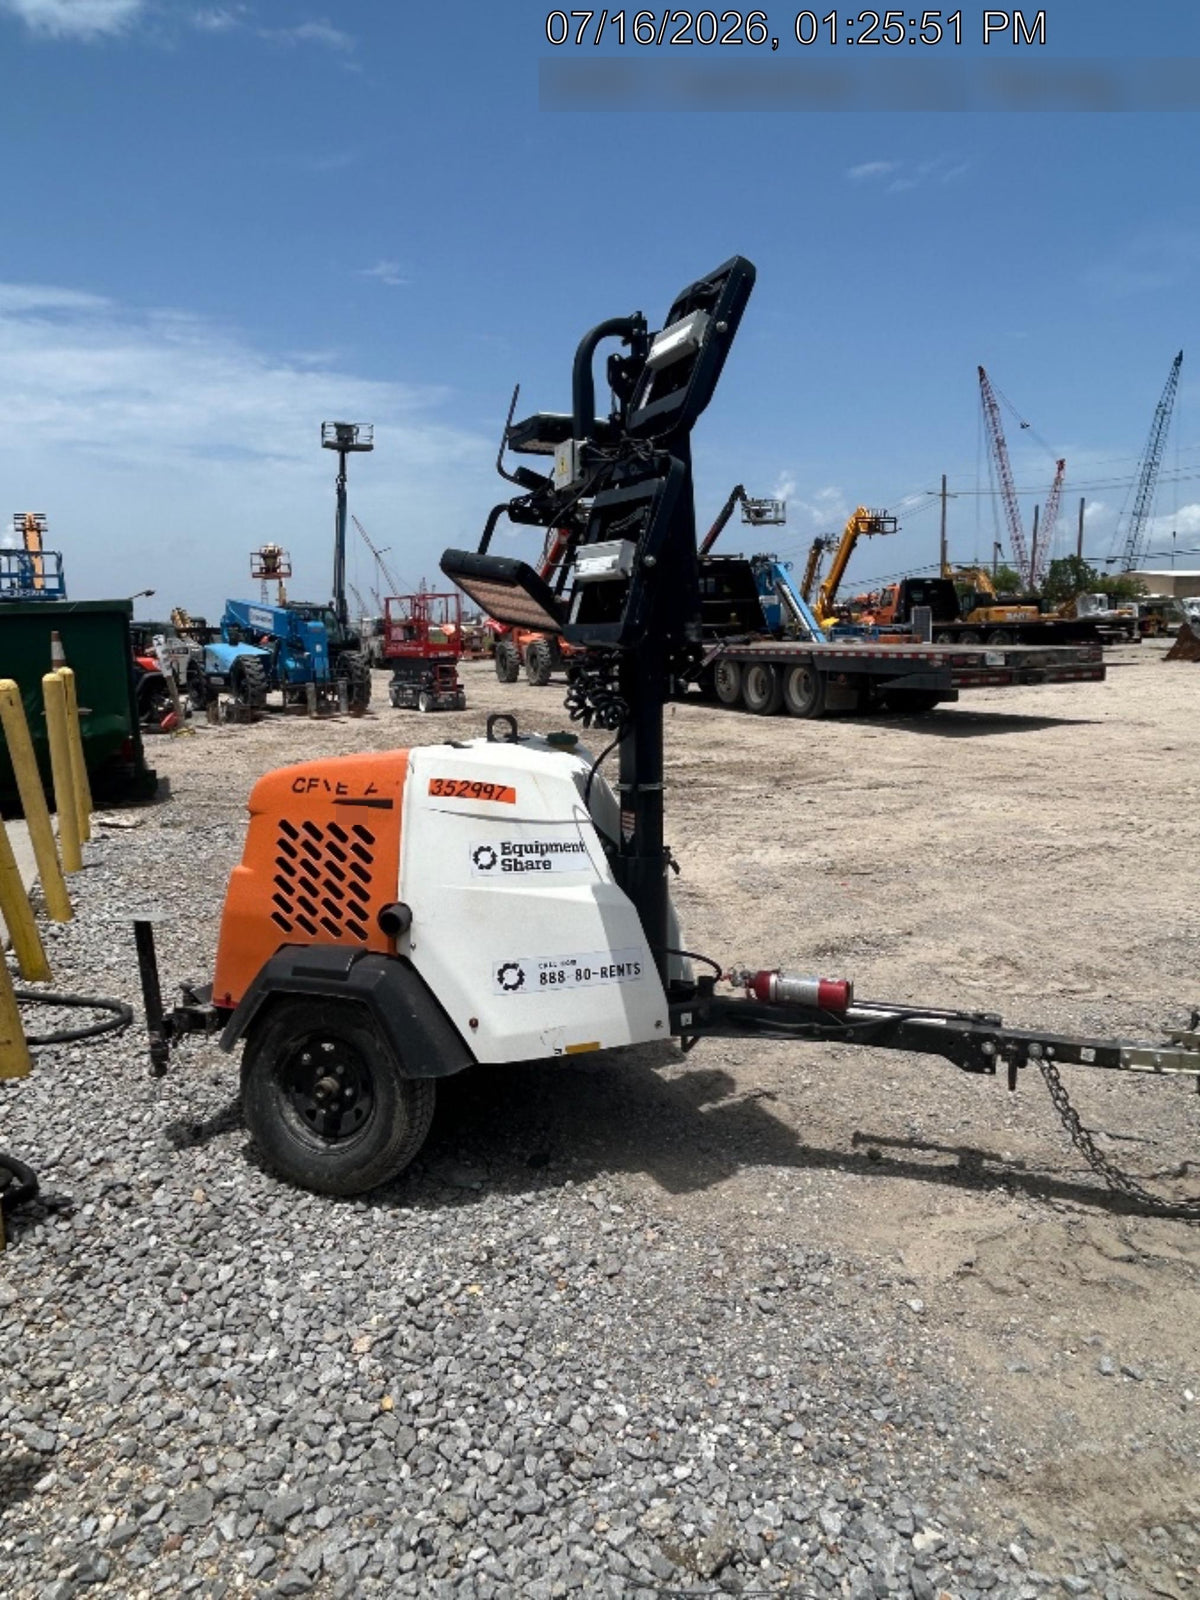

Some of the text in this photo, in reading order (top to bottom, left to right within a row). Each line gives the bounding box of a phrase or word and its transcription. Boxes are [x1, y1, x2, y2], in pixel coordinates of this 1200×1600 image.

[431, 778, 508, 801] 352997
[500, 840, 586, 857] Equipment
[501, 858, 552, 872] Share
